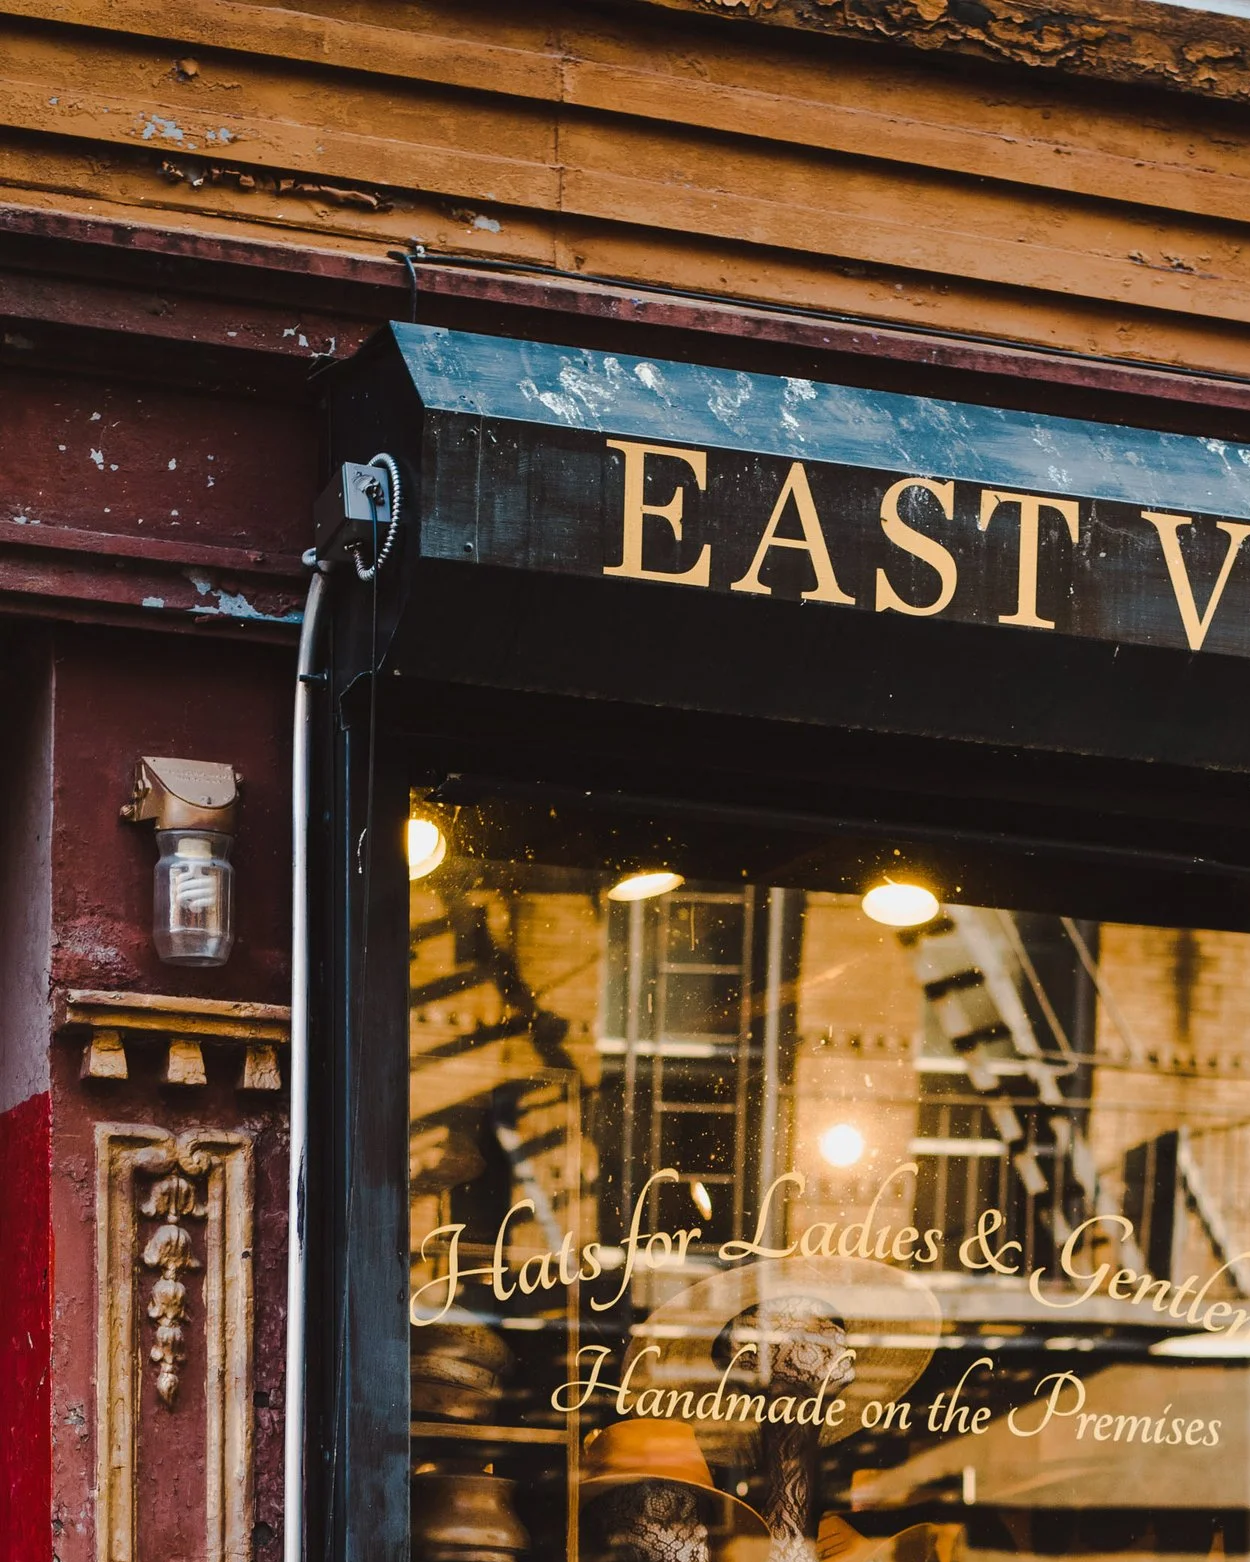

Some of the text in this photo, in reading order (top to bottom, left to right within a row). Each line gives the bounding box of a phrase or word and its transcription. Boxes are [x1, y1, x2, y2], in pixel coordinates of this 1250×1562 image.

[603, 438, 1079, 630] EAST
[409, 1199, 602, 1326] Hats
[590, 1167, 702, 1312] for
[718, 1162, 943, 1262] Ladies
[959, 1208, 1022, 1274] &
[551, 1344, 1223, 1447] Handmade on the Premises
